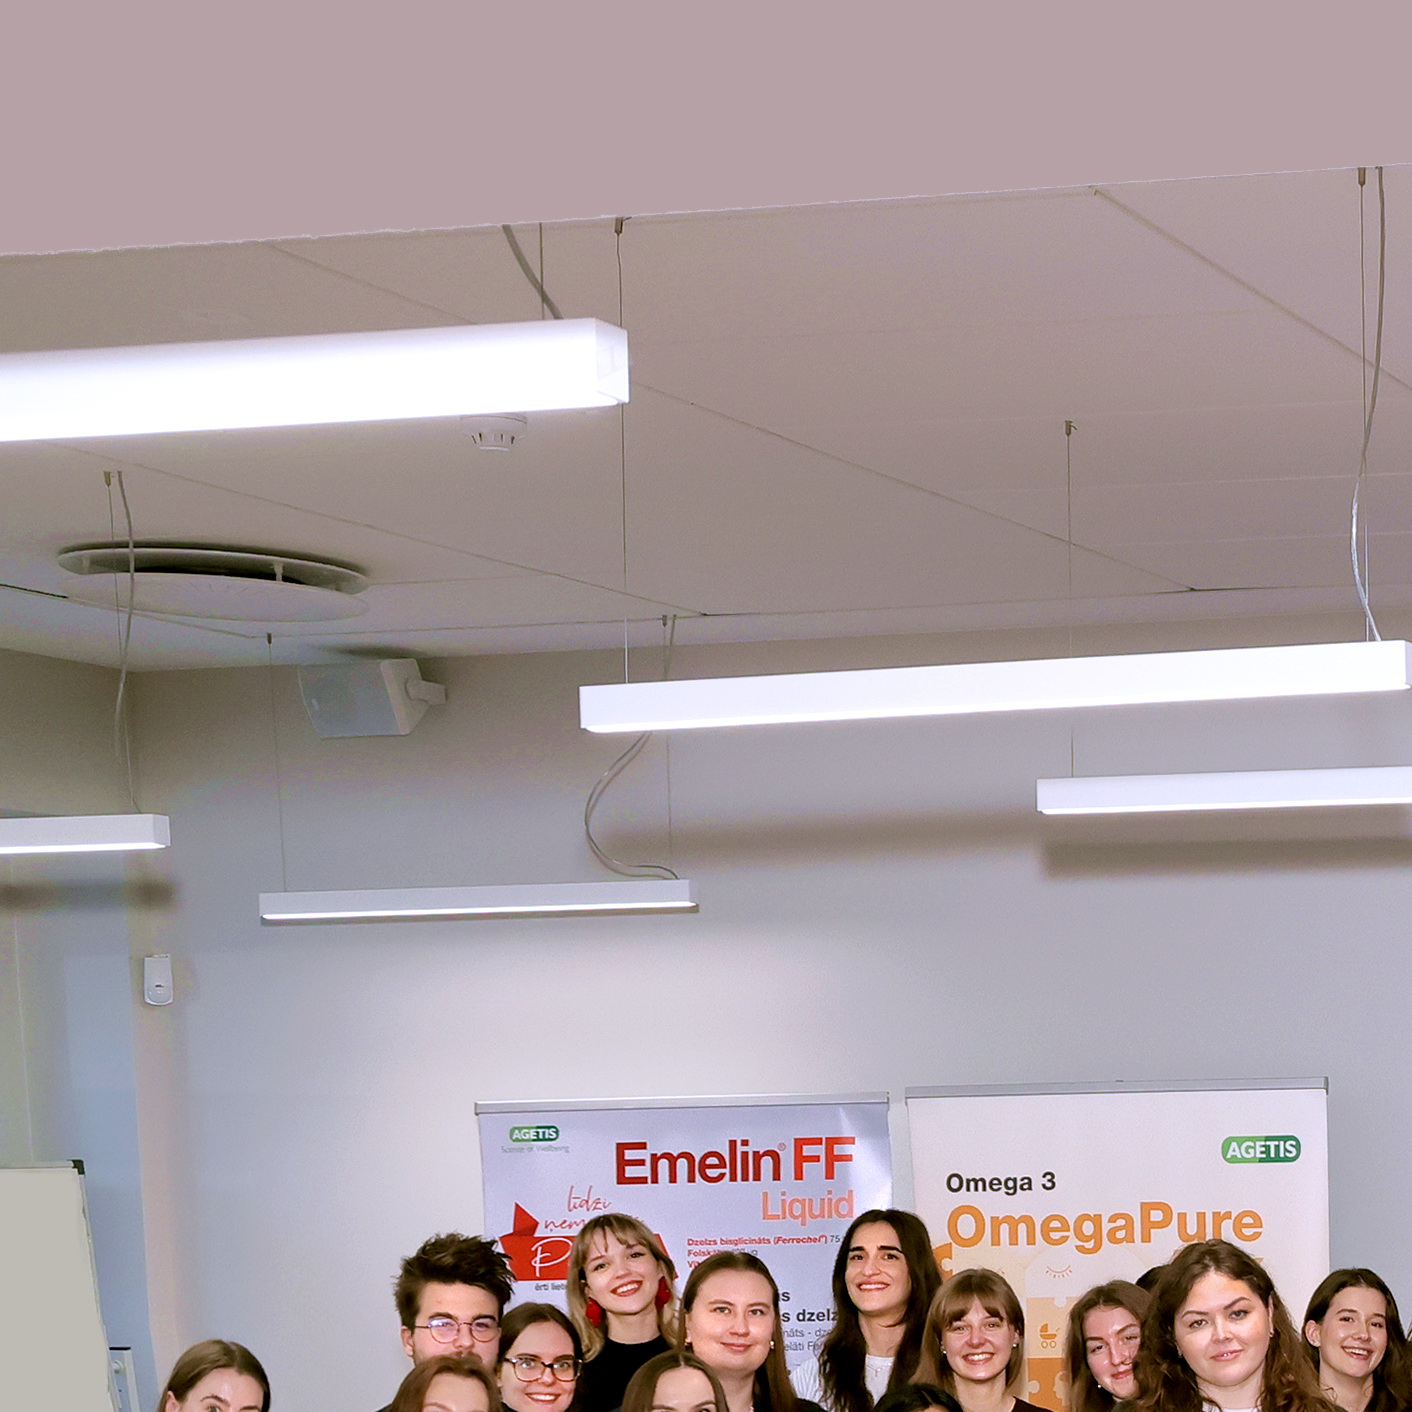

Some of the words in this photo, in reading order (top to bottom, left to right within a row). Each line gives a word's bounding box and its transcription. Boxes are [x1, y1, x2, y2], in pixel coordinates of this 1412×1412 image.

[512, 1128, 557, 1140] AGETIS
[793, 1136, 856, 1181] FF
[1226, 1140, 1297, 1159] AGETIS
[946, 1173, 1033, 1195] Omega
[1041, 1171, 1056, 1190] 3
[762, 1189, 855, 1226] Liquid
[947, 1201, 1263, 1254] OmegaPure
